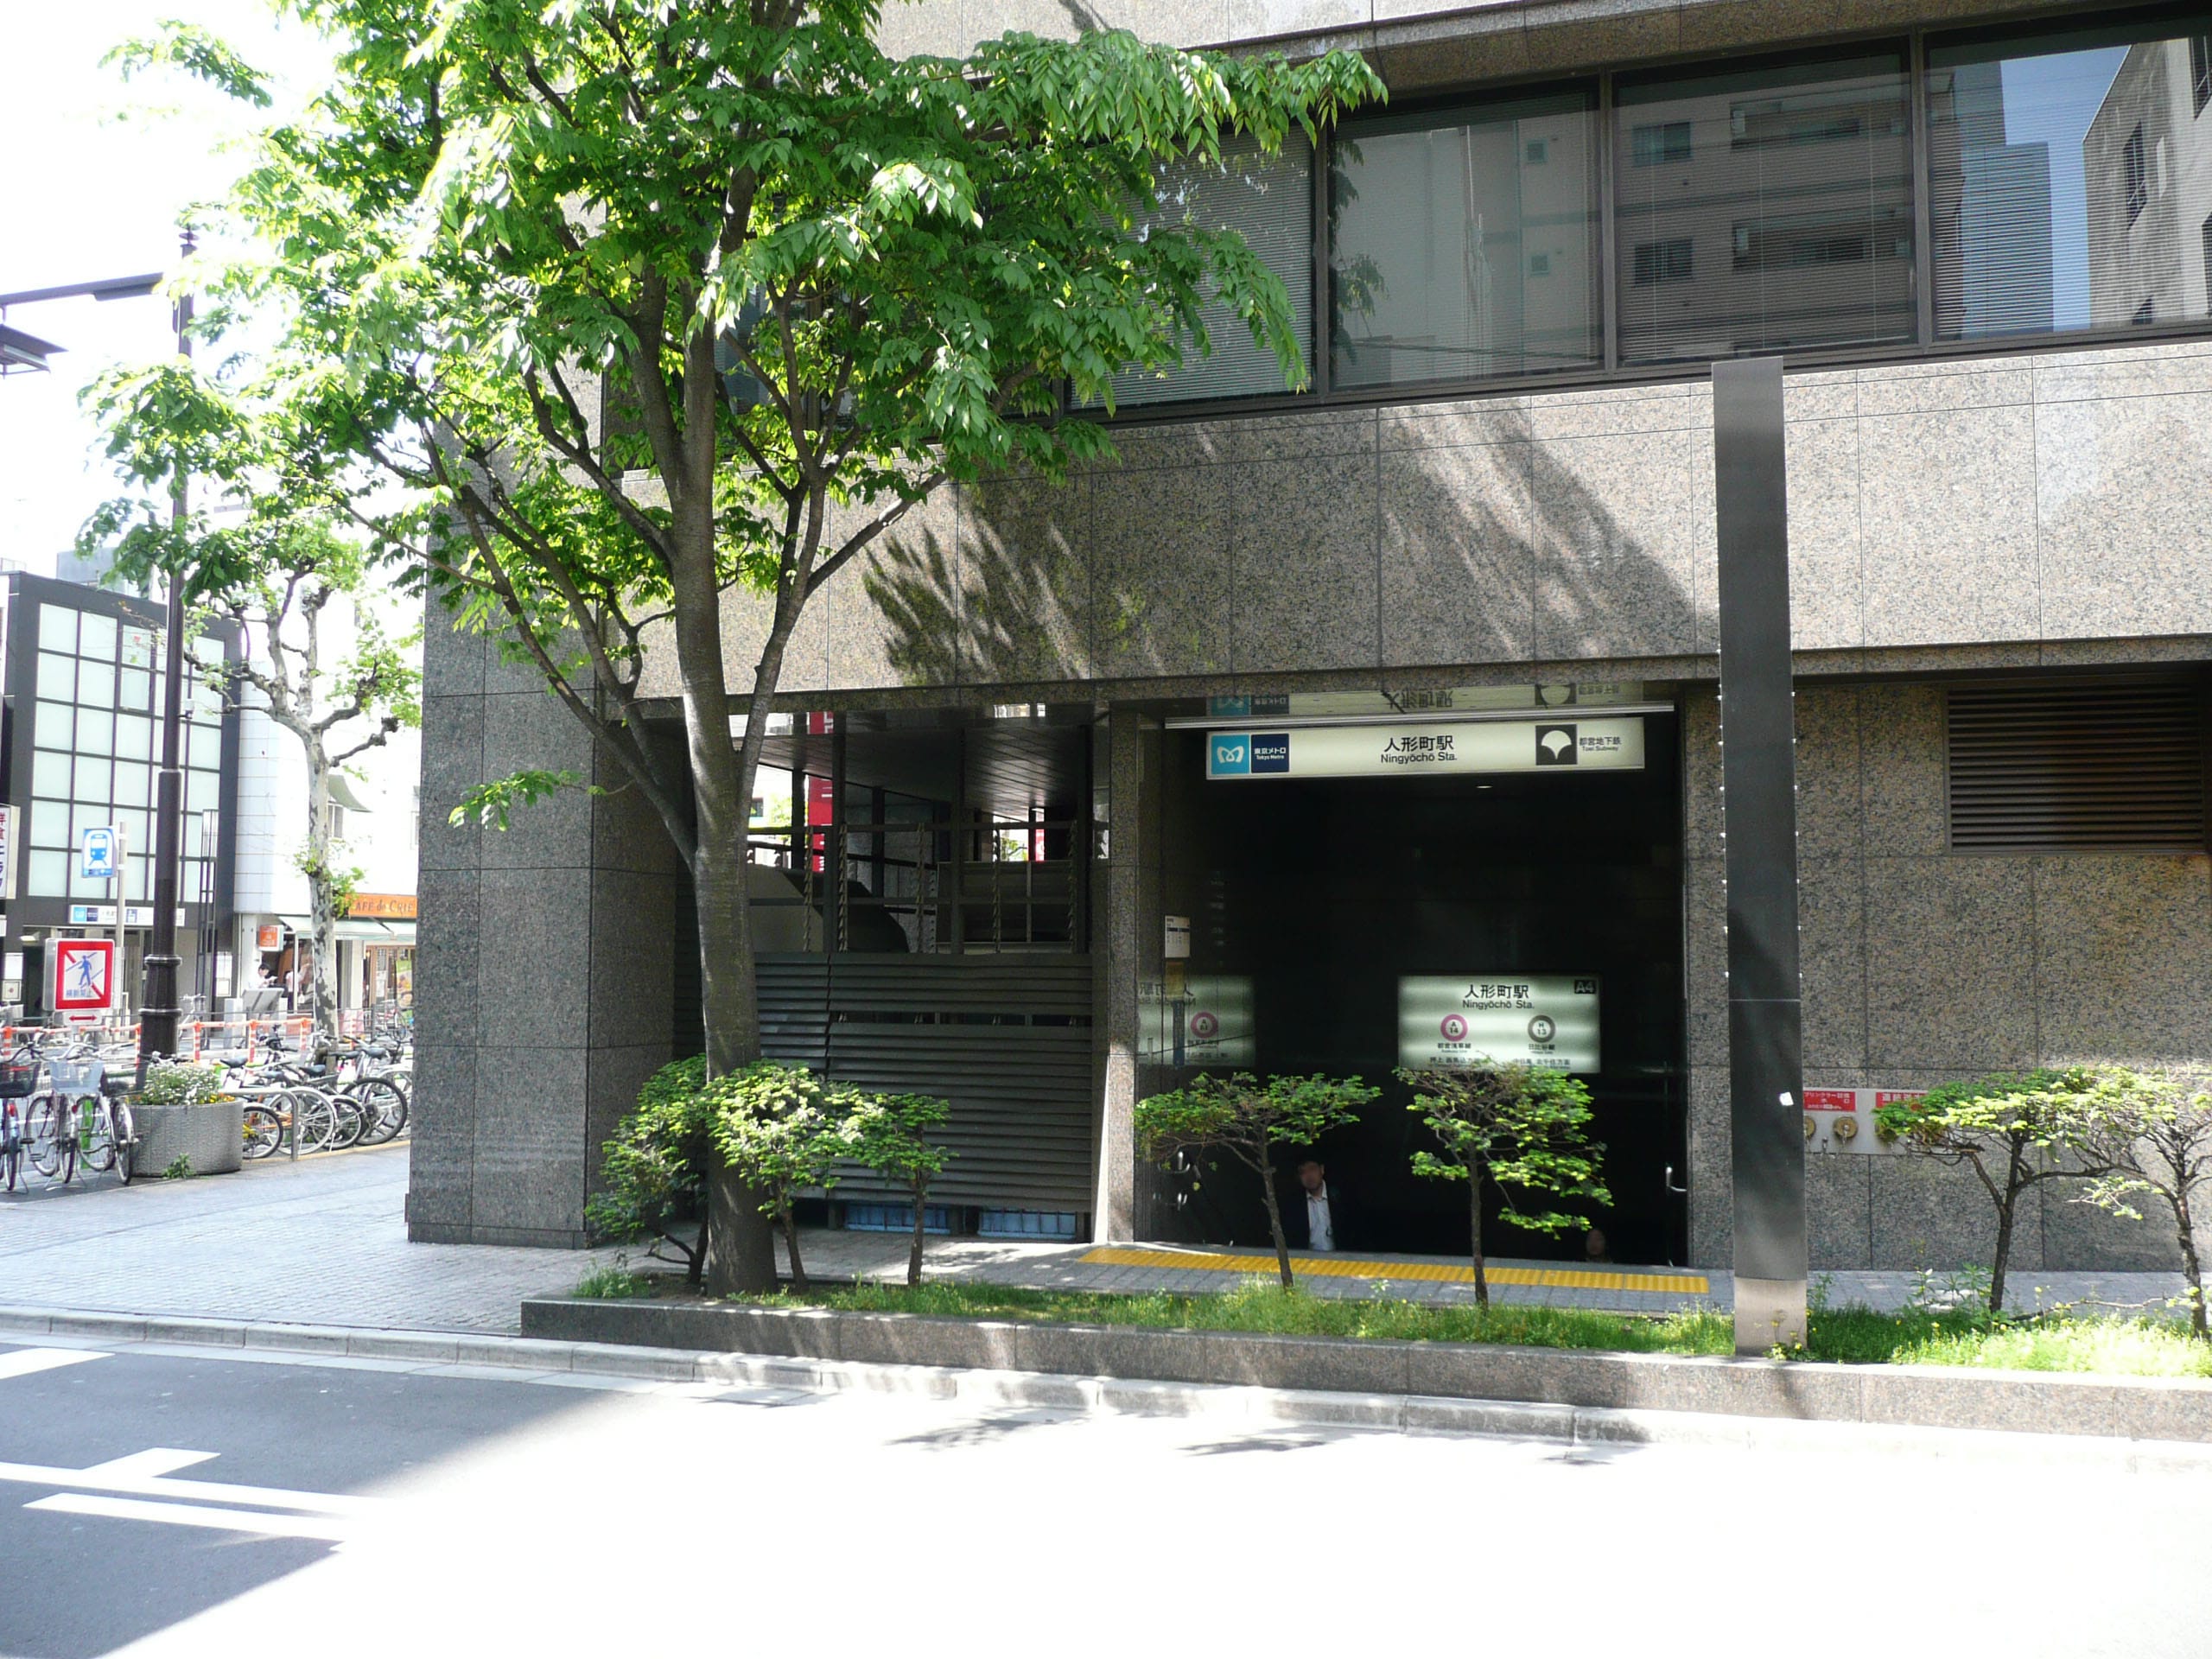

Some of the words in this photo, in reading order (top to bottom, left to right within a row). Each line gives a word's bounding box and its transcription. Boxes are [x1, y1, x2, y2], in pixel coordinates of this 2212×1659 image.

[1384, 735, 1454, 752] 人形町駅
[1580, 736, 1622, 747] 都営地下鉄
[1255, 747, 1287, 755] 東京メトロ
[1438, 752, 1458, 761] Sta.
[1465, 984, 1529, 999] 人形町駅
[1575, 982, 1594, 993] A4
[1516, 1000, 1535, 1009] Sta.
